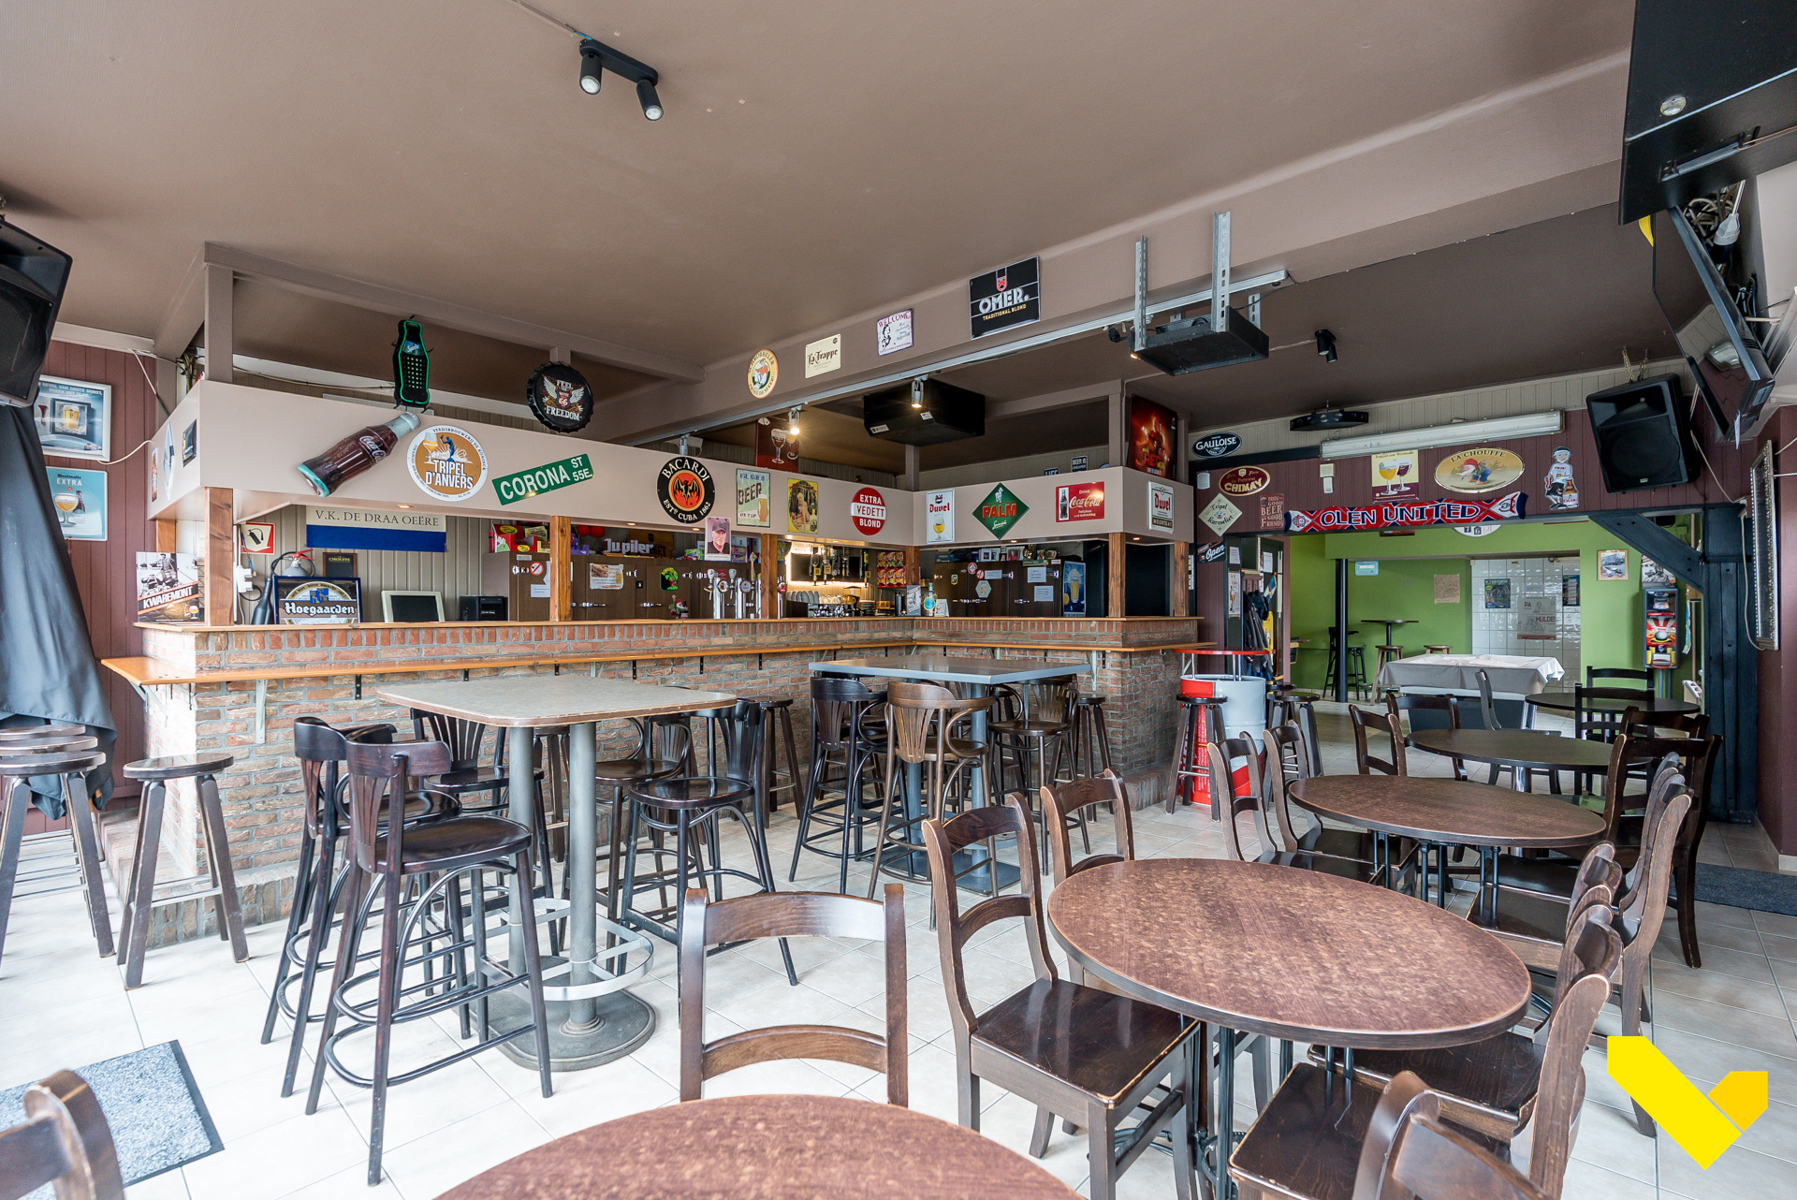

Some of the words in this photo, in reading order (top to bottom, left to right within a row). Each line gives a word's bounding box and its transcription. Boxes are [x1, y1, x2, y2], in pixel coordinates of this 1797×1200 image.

[978, 287, 1030, 314] OMER.
[879, 311, 910, 327] WELCOME
[983, 308, 1011, 320] TRADITIONAL
[1011, 304, 1027, 313] BLOND
[808, 354, 815, 365] La
[815, 349, 838, 361] Trappe
[556, 380, 573, 389] FEEL
[546, 406, 580, 421] FREEDOM
[1195, 436, 1237, 450] GAULOISE
[571, 456, 583, 468] ST
[1463, 450, 1506, 458] CHOUFFE
[433, 459, 466, 476] TRIPEL
[572, 468, 593, 482] 55E
[426, 471, 474, 490] D'ANVERS
[500, 464, 570, 500] CORONA
[1224, 478, 1263, 492] CHIMAY
[738, 482, 762, 505] BEER
[859, 494, 882, 505] EXTRA
[929, 502, 950, 513] Duvel
[1069, 495, 1101, 509] Coca-Cola
[1154, 492, 1171, 512] Duvel
[315, 510, 340, 520] V.K.
[343, 512, 360, 522] DE
[364, 513, 399, 524] DRAA
[402, 515, 439, 526] OEËRE
[678, 513, 698, 522] CUBA
[699, 501, 711, 516] 1862
[856, 505, 885, 518] VEDETT
[982, 503, 1017, 519] PALM
[1261, 505, 1282, 516] BEER
[1320, 506, 1377, 527] OLEN
[1382, 502, 1480, 522] UNITED
[859, 519, 881, 528] BLOND
[603, 538, 654, 555] Jupiler
[1205, 544, 1225, 560] Open
[143, 585, 193, 609] KWAREMONT
[284, 602, 355, 617] Hoegaarden
